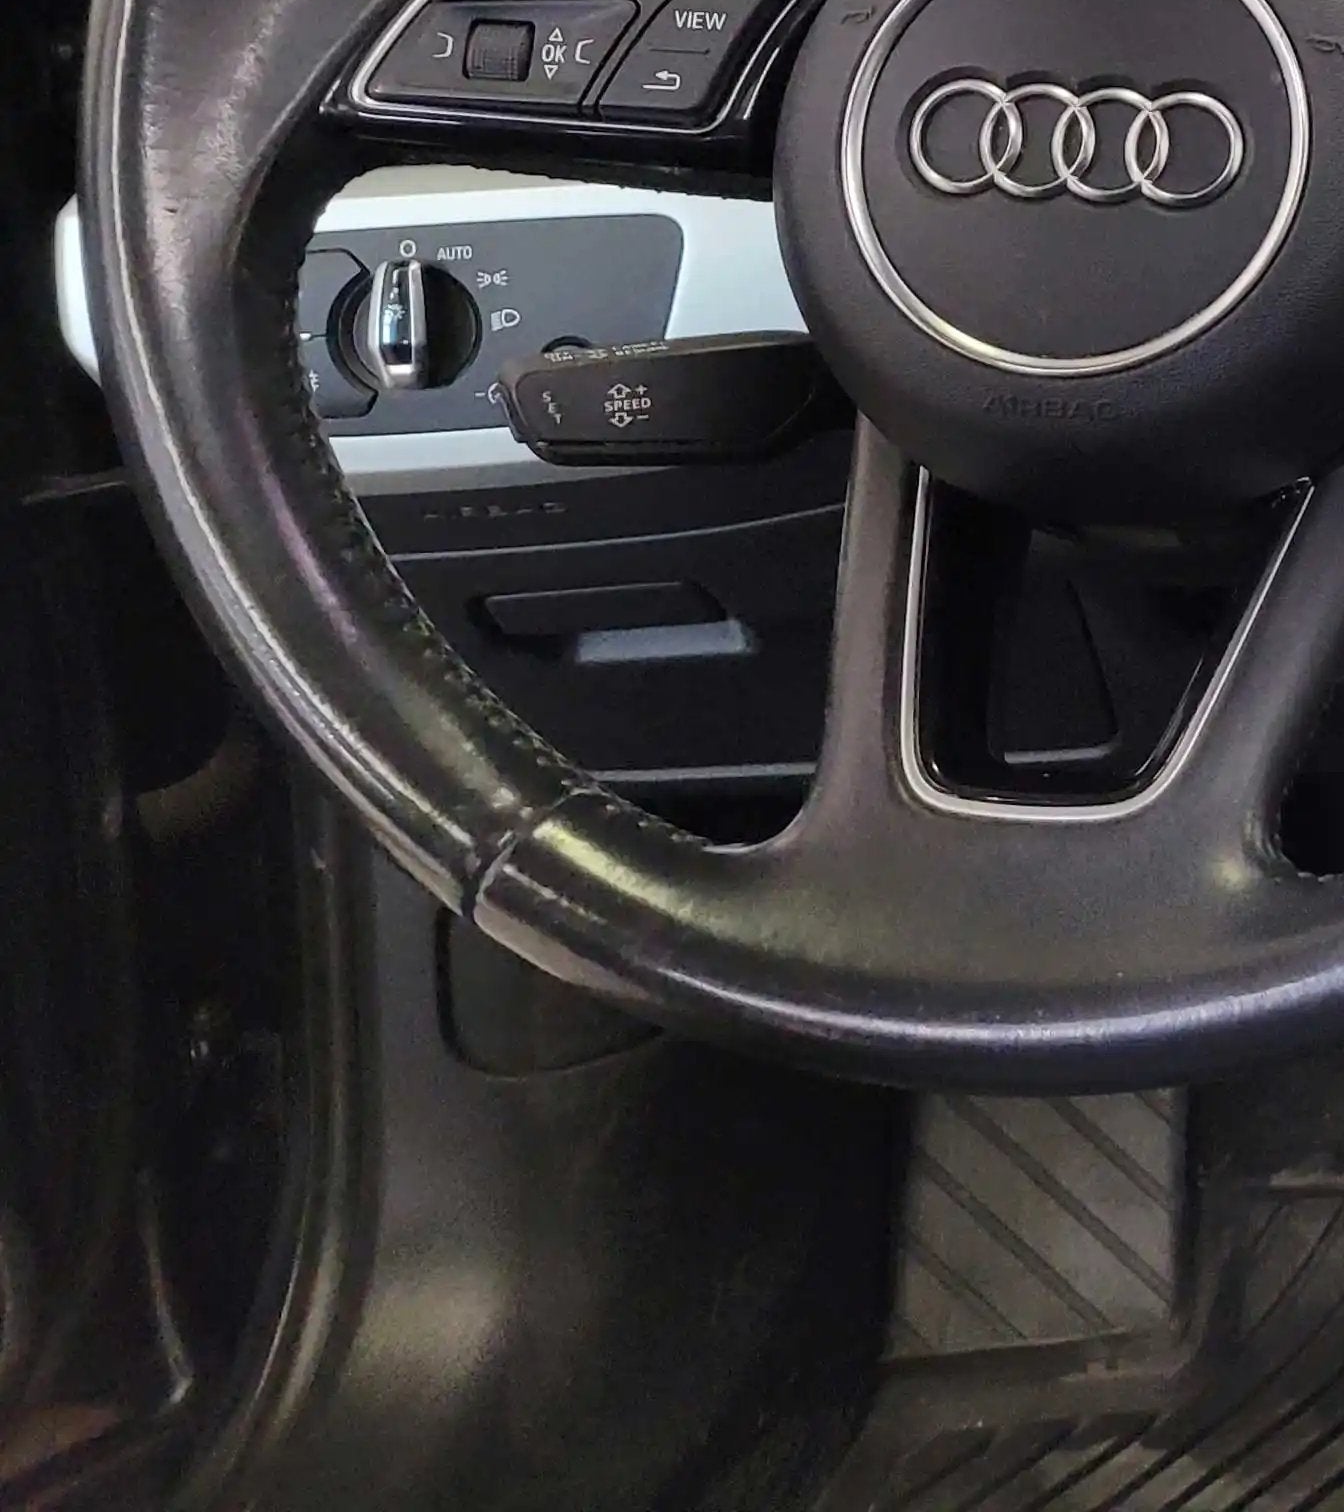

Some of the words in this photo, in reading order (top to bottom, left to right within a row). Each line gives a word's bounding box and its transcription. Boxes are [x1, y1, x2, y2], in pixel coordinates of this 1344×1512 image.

[674, 10, 727, 31] VIEW
[541, 44, 567, 65] OK
[437, 246, 473, 261] AUTO
[603, 397, 652, 413] SPEED
